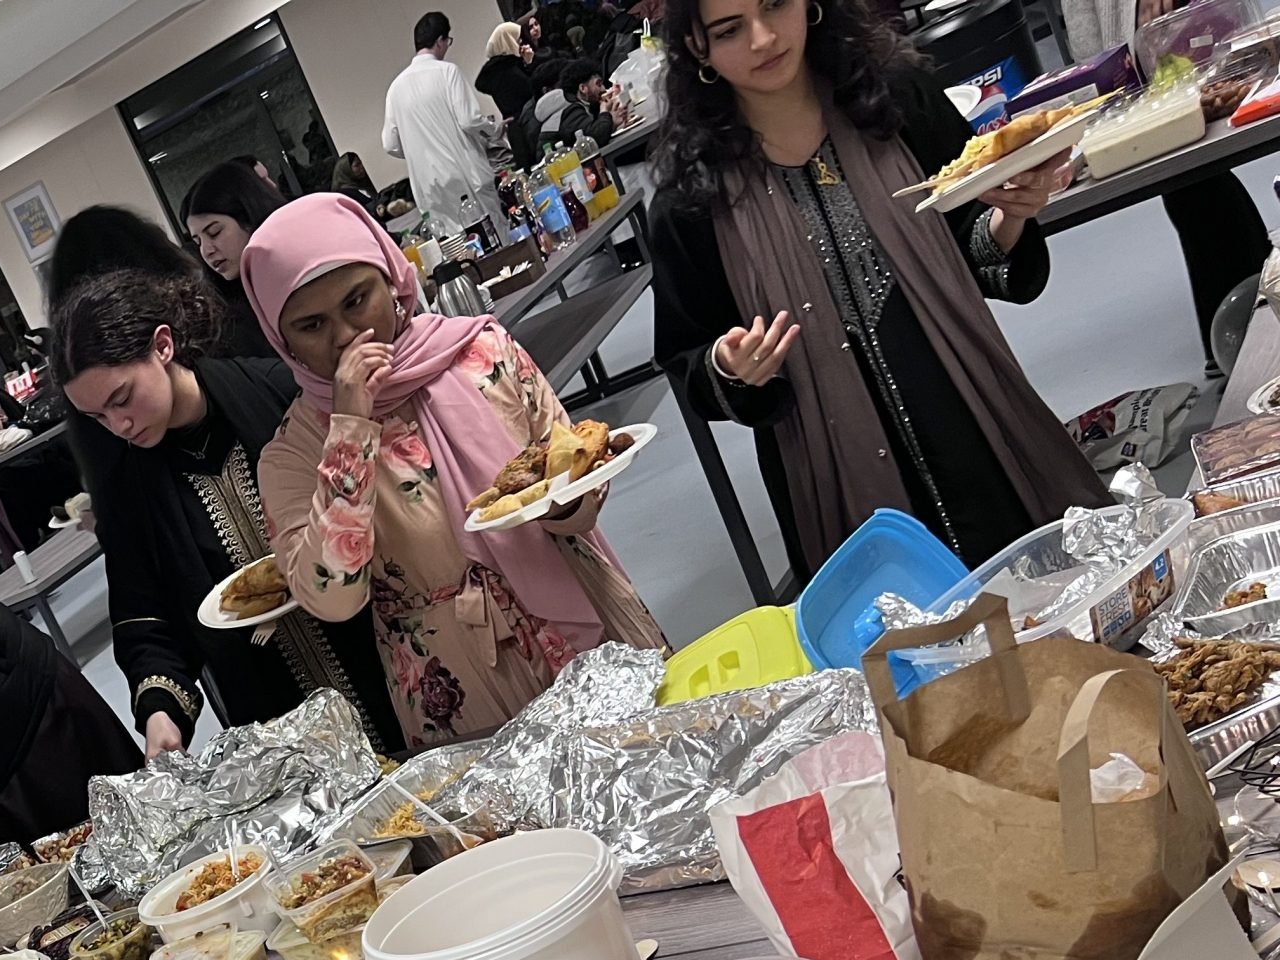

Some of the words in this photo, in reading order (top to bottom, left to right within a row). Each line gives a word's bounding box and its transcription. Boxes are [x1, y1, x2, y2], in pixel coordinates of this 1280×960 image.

[962, 66, 1002, 87] PSI
[1099, 586, 1128, 616] STORE
[1100, 602, 1129, 626] FRESH
